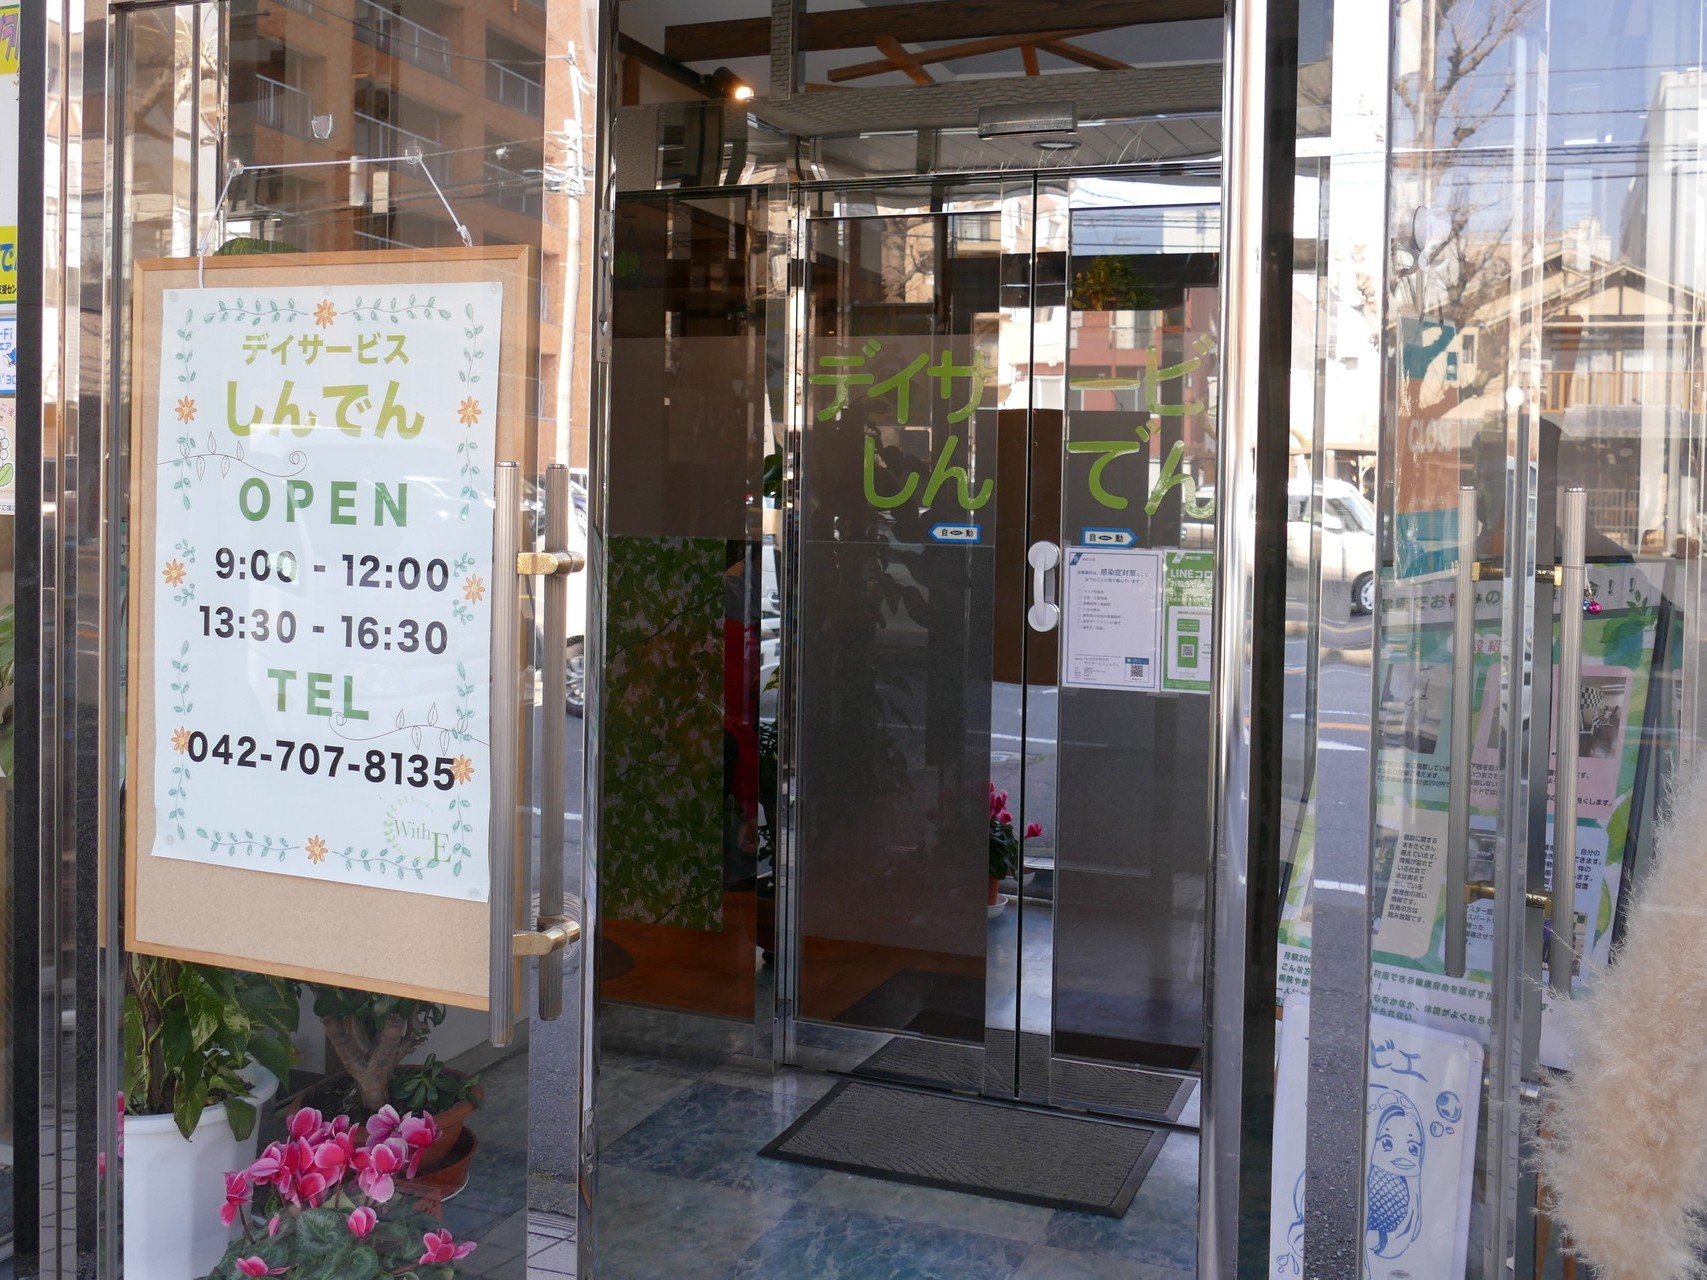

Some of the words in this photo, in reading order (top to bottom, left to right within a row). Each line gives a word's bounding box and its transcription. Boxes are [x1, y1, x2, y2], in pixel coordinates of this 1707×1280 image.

[0, 243, 16, 271] で
[242, 333, 410, 366] デイサービス
[226, 379, 425, 440] しんでん
[239, 477, 408, 527] OPEN
[215, 547, 298, 583] 9:00
[342, 554, 449, 592] 12:00
[199, 605, 297, 643] 13:30
[341, 615, 448, 655] 16:30
[267, 668, 369, 721] TEL
[187, 731, 455, 791] 042-707-8135
[394, 819, 431, 840] With
[431, 831, 452, 863] E
